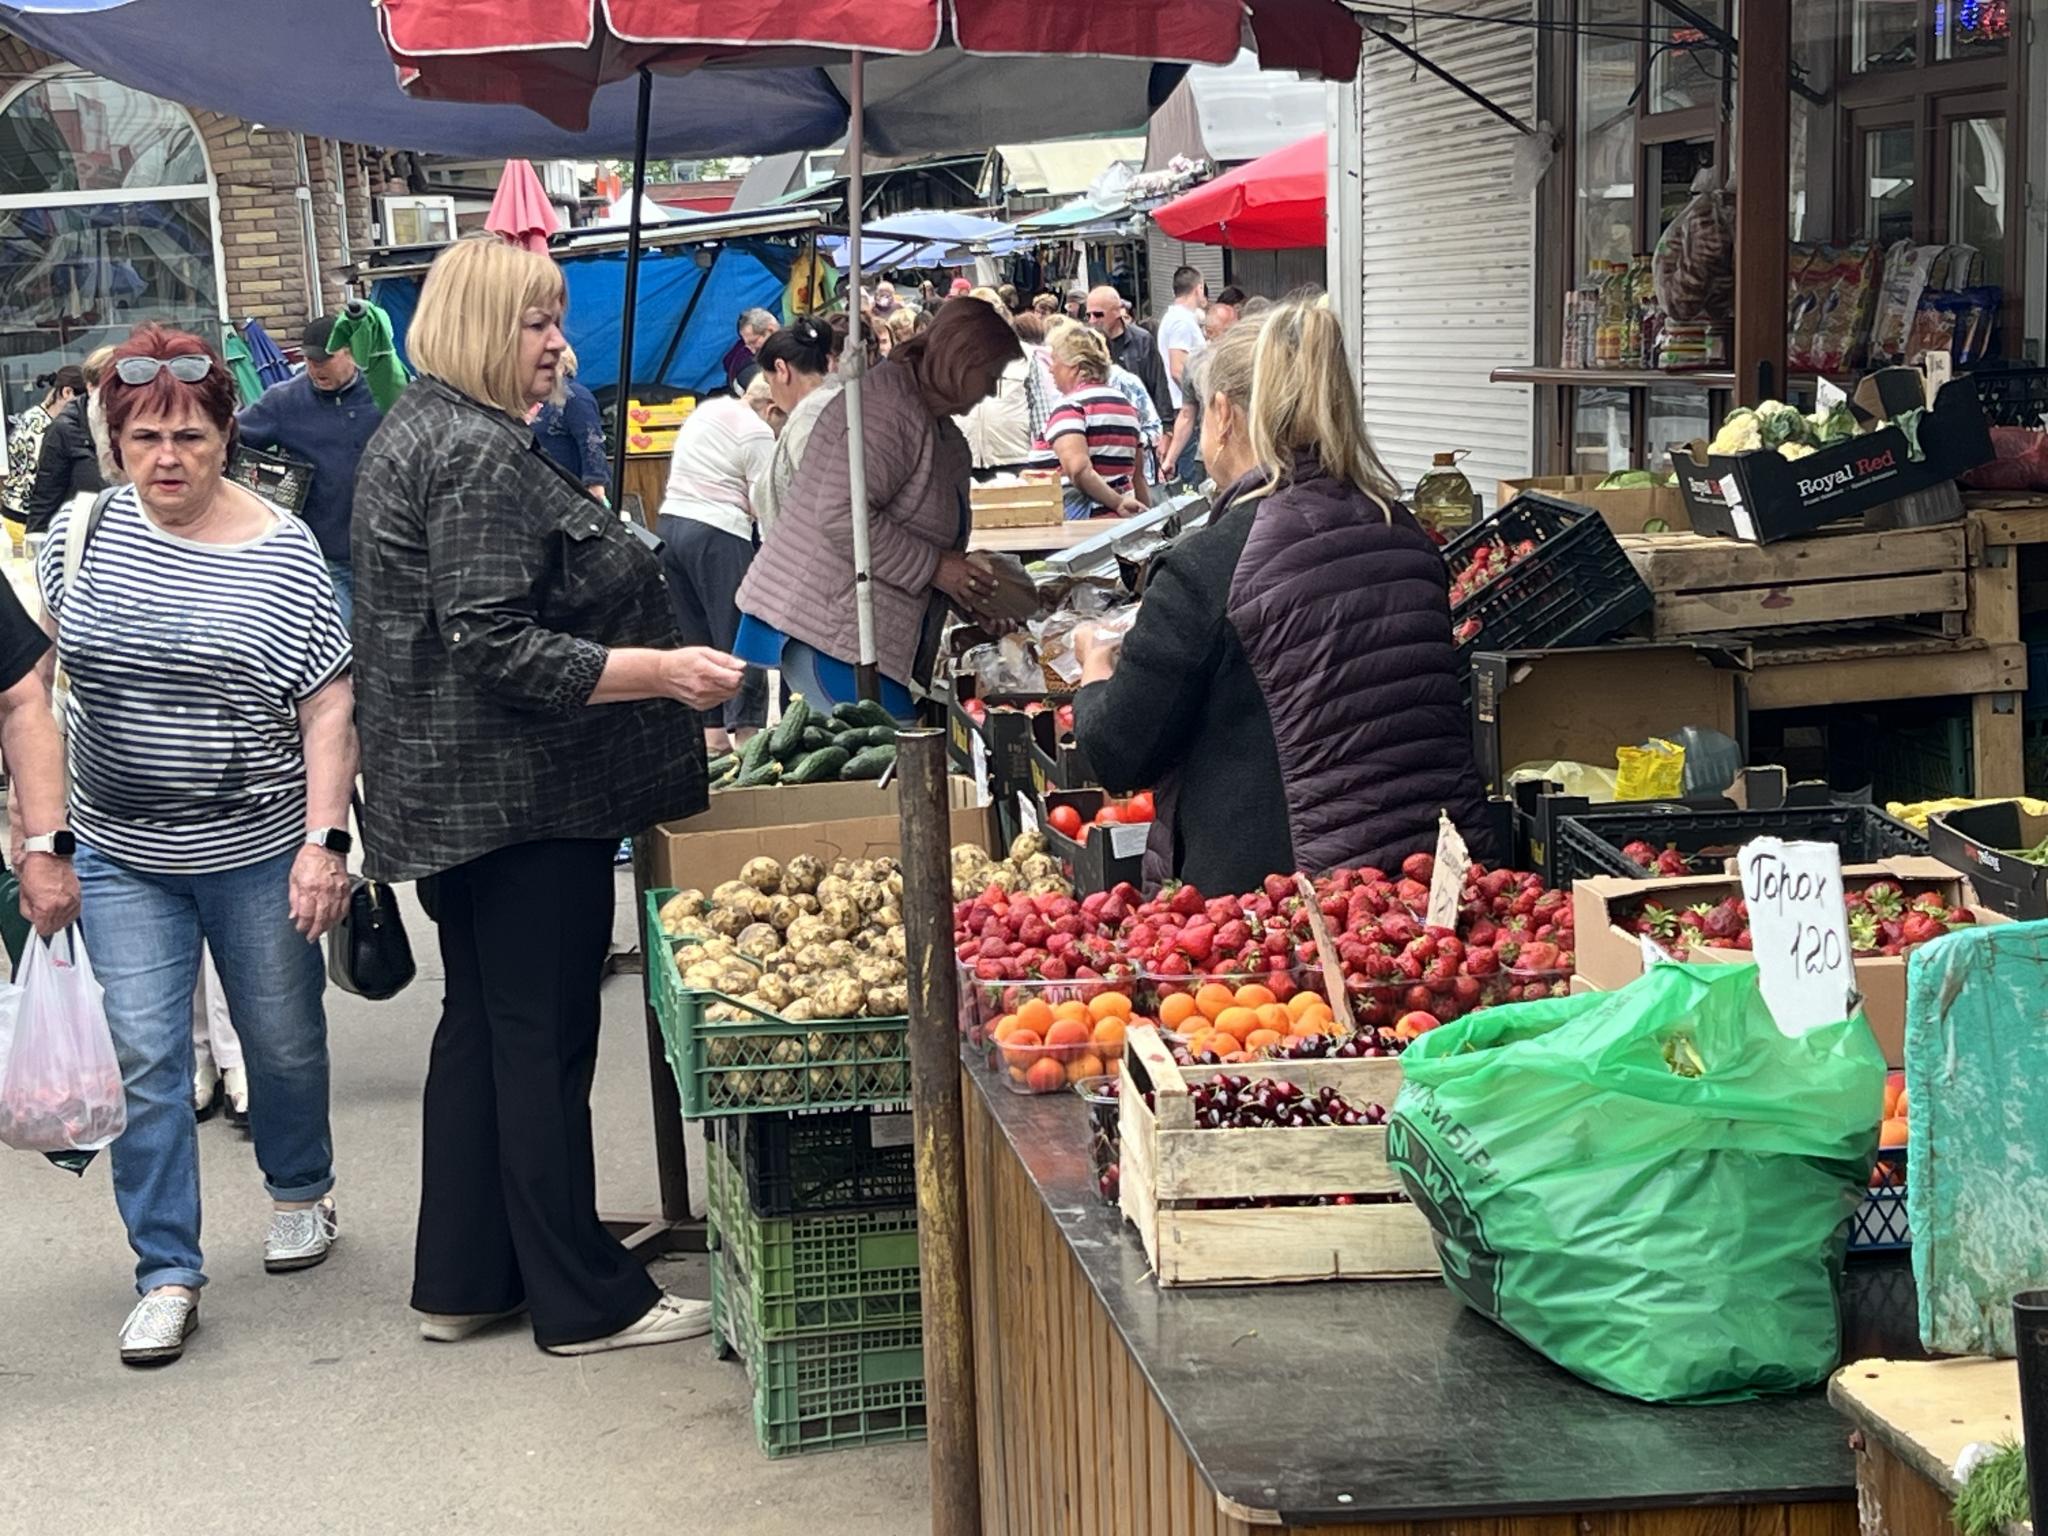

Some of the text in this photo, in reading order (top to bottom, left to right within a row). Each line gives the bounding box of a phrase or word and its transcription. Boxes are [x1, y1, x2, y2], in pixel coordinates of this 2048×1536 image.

[1796, 463, 1855, 497] Royal
[1856, 449, 1896, 476] Red
[1790, 921, 1842, 980] 120
